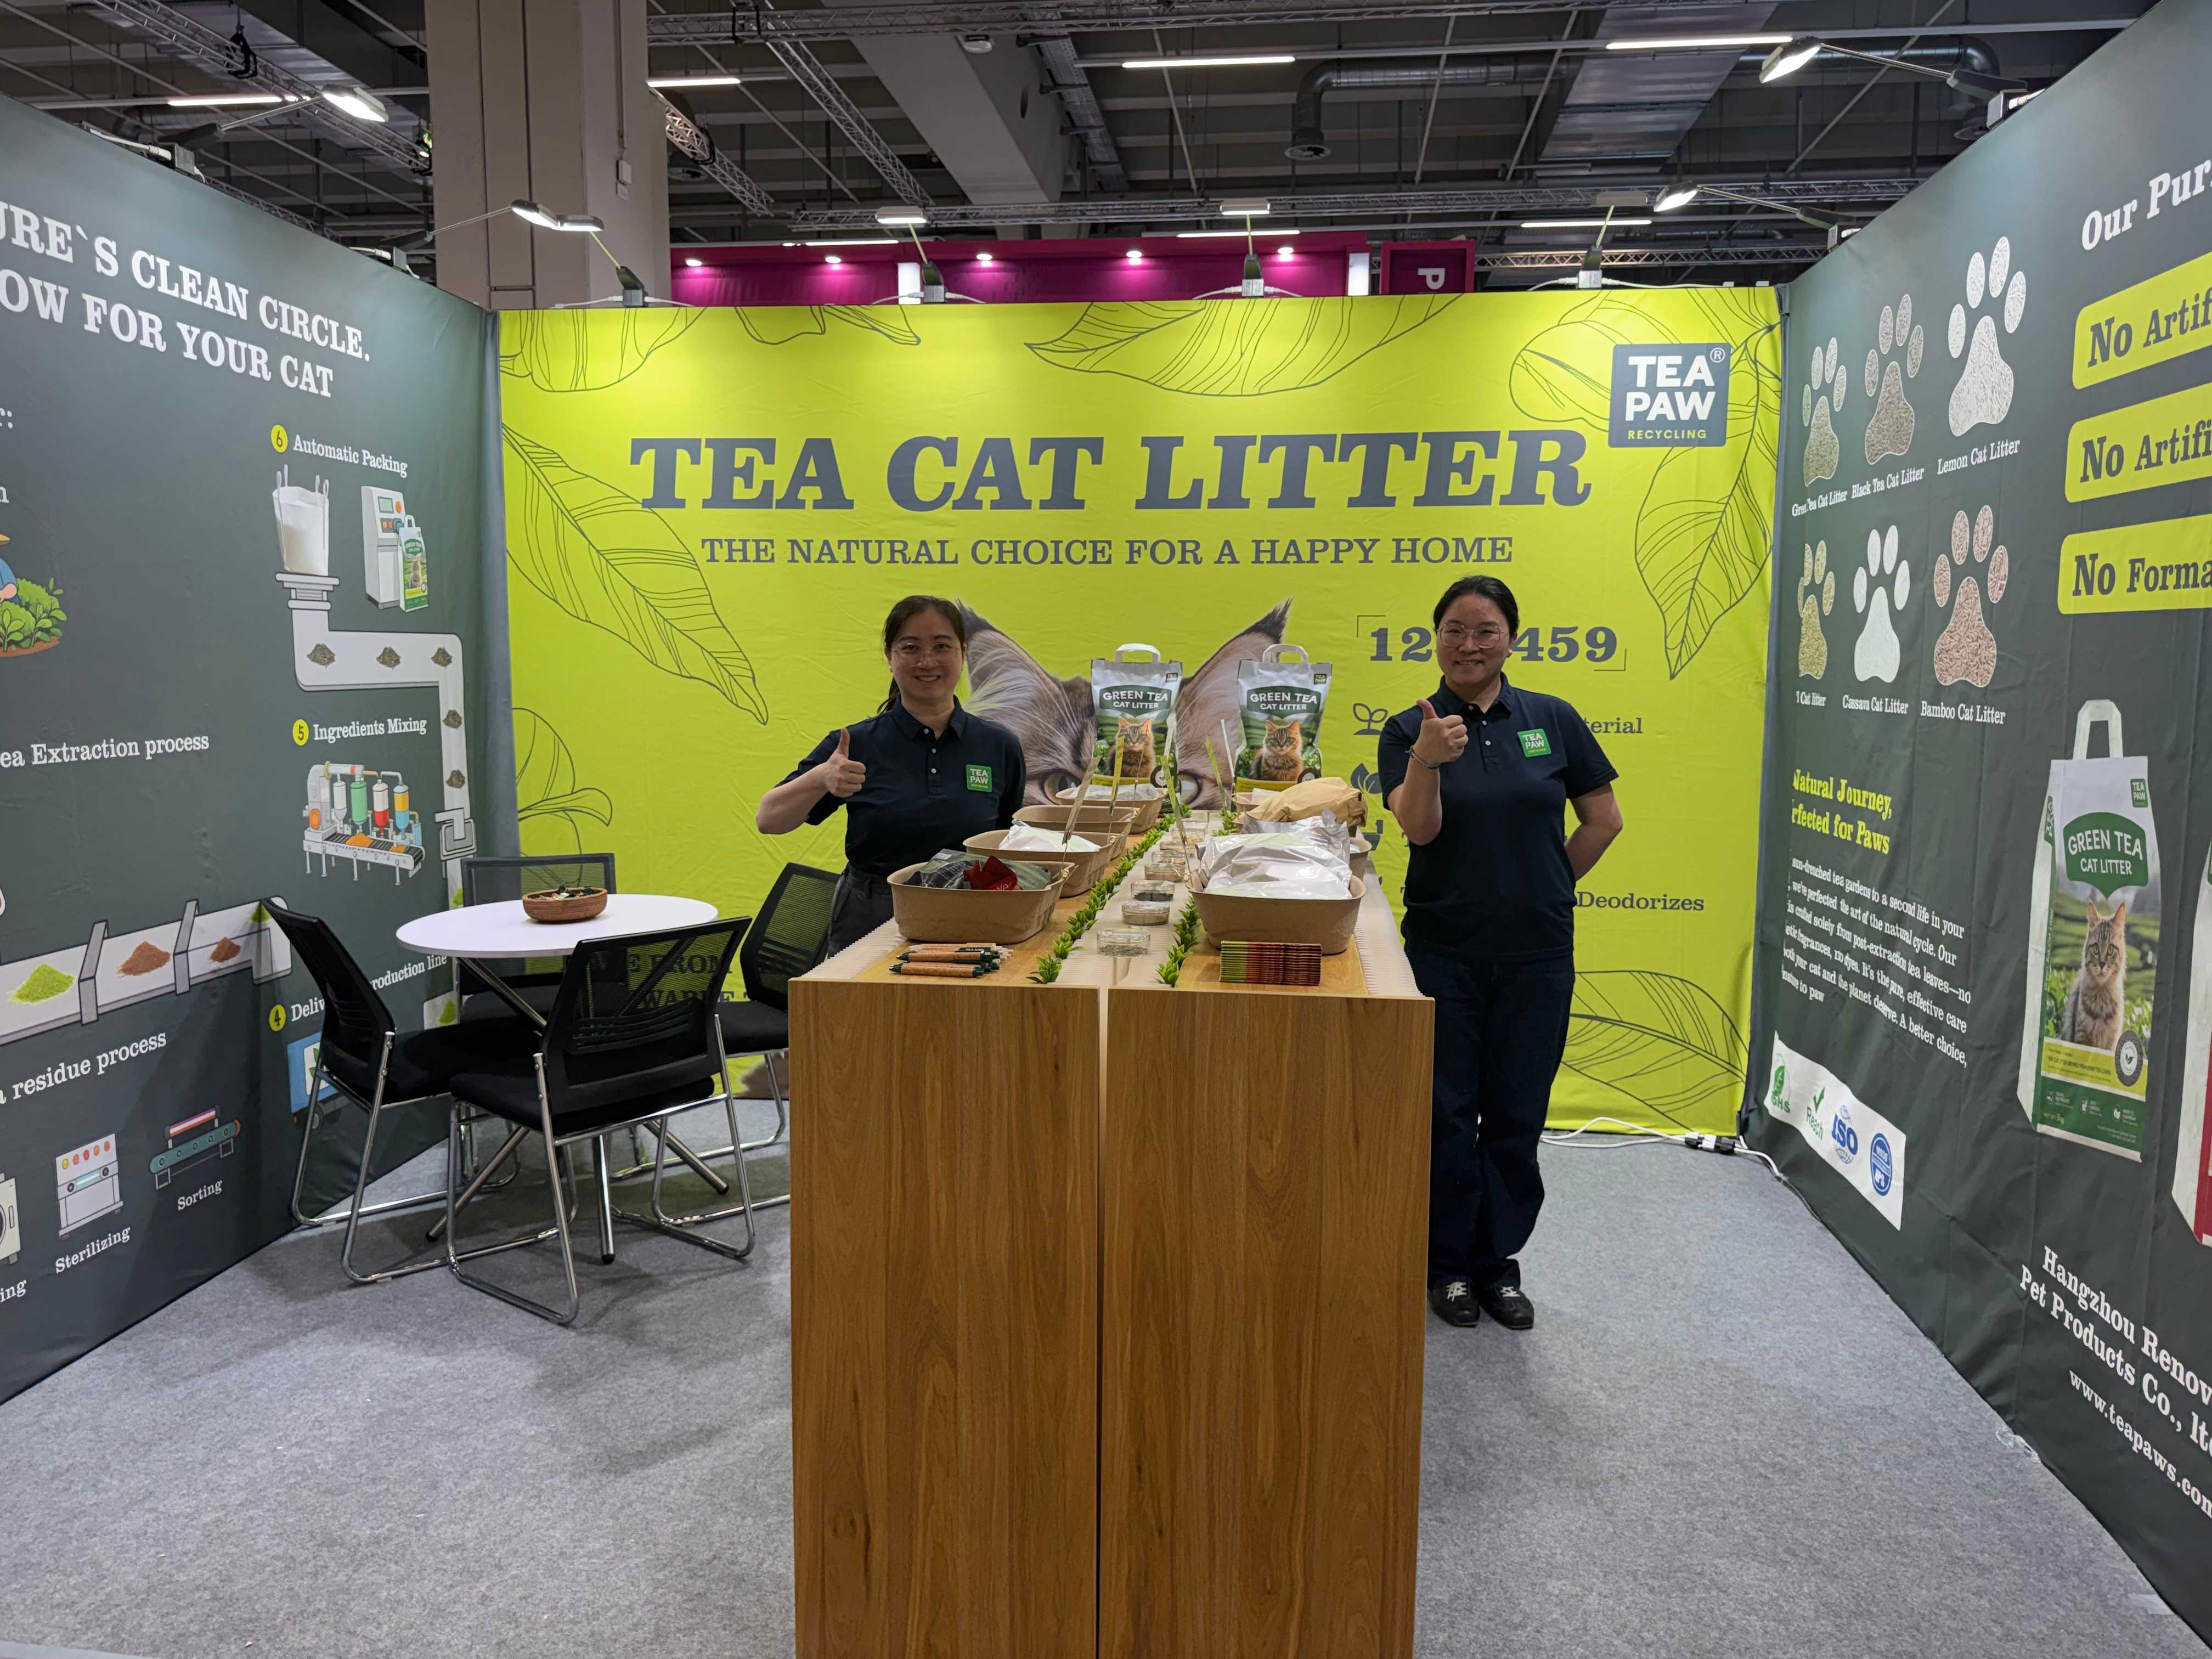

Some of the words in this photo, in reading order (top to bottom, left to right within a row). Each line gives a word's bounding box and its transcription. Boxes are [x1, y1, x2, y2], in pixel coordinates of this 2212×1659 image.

[2082, 199, 2137, 250] Our
[2147, 159, 2212, 219] Pur
[132, 250, 248, 321] CLEAN
[259, 296, 370, 362] CIRCLE.
[0, 269, 69, 323] OW
[82, 293, 167, 353] FOR
[177, 322, 272, 381] YOUR
[280, 355, 333, 398] CAT
[2087, 317, 2132, 368] No
[1628, 356, 1715, 387] TEA
[1626, 392, 1716, 421] PAW
[1628, 430, 1706, 439] RECYCLING
[294, 434, 359, 464] Automatic
[362, 450, 408, 478] Packing
[630, 438, 854, 509] TEA
[887, 436, 1103, 511] CAT
[1135, 430, 1592, 509] LITTER
[1937, 450, 1969, 475] Lemon
[1971, 446, 1987, 466] Cat
[1989, 439, 2020, 460] Litter
[2080, 436, 2124, 483] No
[1851, 481, 1871, 499] Black
[1872, 478, 1884, 493] Tea
[1886, 472, 1899, 489] Cat
[1901, 467, 1925, 485] Litter
[1818, 494, 1828, 509] Cat
[1829, 490, 1847, 505] Litter
[702, 538, 775, 563] THE
[788, 539, 958, 565] NATURAL
[971, 539, 1111, 566] CHOICE
[1126, 539, 1203, 564] FOR
[1215, 539, 1240, 564] A
[1252, 538, 1381, 563] HAPPY
[1392, 537, 1513, 563] HOME
[2072, 553, 2115, 596] No
[1103, 691, 1143, 701] GREEN
[1148, 692, 1168, 702] TEA
[1113, 701, 1130, 709] CAT
[1132, 701, 1159, 709] LITTER
[1250, 692, 1293, 703] GREEN
[1296, 694, 1317, 704] TEA
[1801, 691, 1810, 705] Cat
[1842, 695, 1870, 710] Cassava
[1871, 697, 1883, 712] Cat
[1884, 698, 1909, 714] Litter
[1921, 701, 1957, 719] Bamboo
[1958, 704, 1973, 721] Cat
[1976, 704, 2005, 724] Litter
[313, 720, 385, 742] Ingredients
[387, 718, 427, 737] Mixing
[1522, 733, 1543, 741] TEA
[1525, 740, 1544, 749] PAW
[31, 738, 140, 765] Extraction
[145, 735, 209, 760] process
[970, 769, 988, 777] TEA
[2132, 782, 2145, 791] TEA
[1837, 779, 1892, 821] Journey,
[2133, 792, 2146, 800] PAW
[1833, 814, 1853, 841] for
[1856, 821, 1889, 854] Paws
[2068, 829, 2110, 855] GREEN
[2114, 829, 2143, 860] TEA
[2080, 857, 2097, 873] CAT
[2100, 858, 2132, 876] LITTER
[1576, 891, 1704, 911] Deodorizes
[1792, 857, 1831, 882] sun-drenched
[1833, 871, 1844, 887] tea
[1846, 879, 1871, 899] gardens
[1872, 888, 1880, 902] to
[1882, 894, 1887, 905] a
[1889, 896, 1915, 918] second
[1917, 904, 1929, 924] life
[1931, 911, 1940, 929] in
[1943, 918, 1964, 938] your
[1807, 889, 1837, 910] perfected
[1840, 899, 1849, 915] the
[1850, 907, 1861, 921] art
[1862, 910, 1869, 924] of
[1870, 913, 1882, 930] the
[1884, 922, 1911, 945] natural
[1913, 935, 1936, 956] cycle.
[1938, 945, 1956, 966] Our
[1813, 916, 1835, 936] solely
[1836, 922, 1852, 943] from
[1853, 934, 1906, 973] post-extraction
[1908, 960, 1920, 979] tea
[370, 963, 425, 990] roduction
[427, 955, 447, 970] line
[1799, 980, 1807, 994] to
[1809, 987, 1824, 1002] paw
[1834, 950, 1843, 963] no
[1844, 953, 1860, 973] dyes.
[1877, 969, 1889, 989] the
[1907, 991, 1944, 1021] effective
[1946, 1012, 1966, 1033] care
[1809, 963, 1821, 977] cat
[1822, 969, 1836, 985] and
[1838, 974, 1848, 991] the
[1849, 982, 1871, 1005] planet
[1874, 995, 1898, 1024] deserve.
[1899, 1013, 1907, 1029] A
[1909, 1017, 1934, 1045] better
[1937, 1036, 1967, 1068] choice,
[13, 1059, 91, 1099] residue
[97, 1032, 166, 1075] process
[1807, 1107, 1823, 1139] Reach
[1831, 1114, 1858, 1155] ISO
[177, 1178, 223, 1210] Sorting
[56, 1227, 131, 1273] Sterilizing
[2042, 1245, 2135, 1344] Hangzhou
[2019, 1265, 2046, 1307] Pet
[2051, 1292, 2135, 1386] Products
[2142, 1373, 2182, 1432] Co.,
